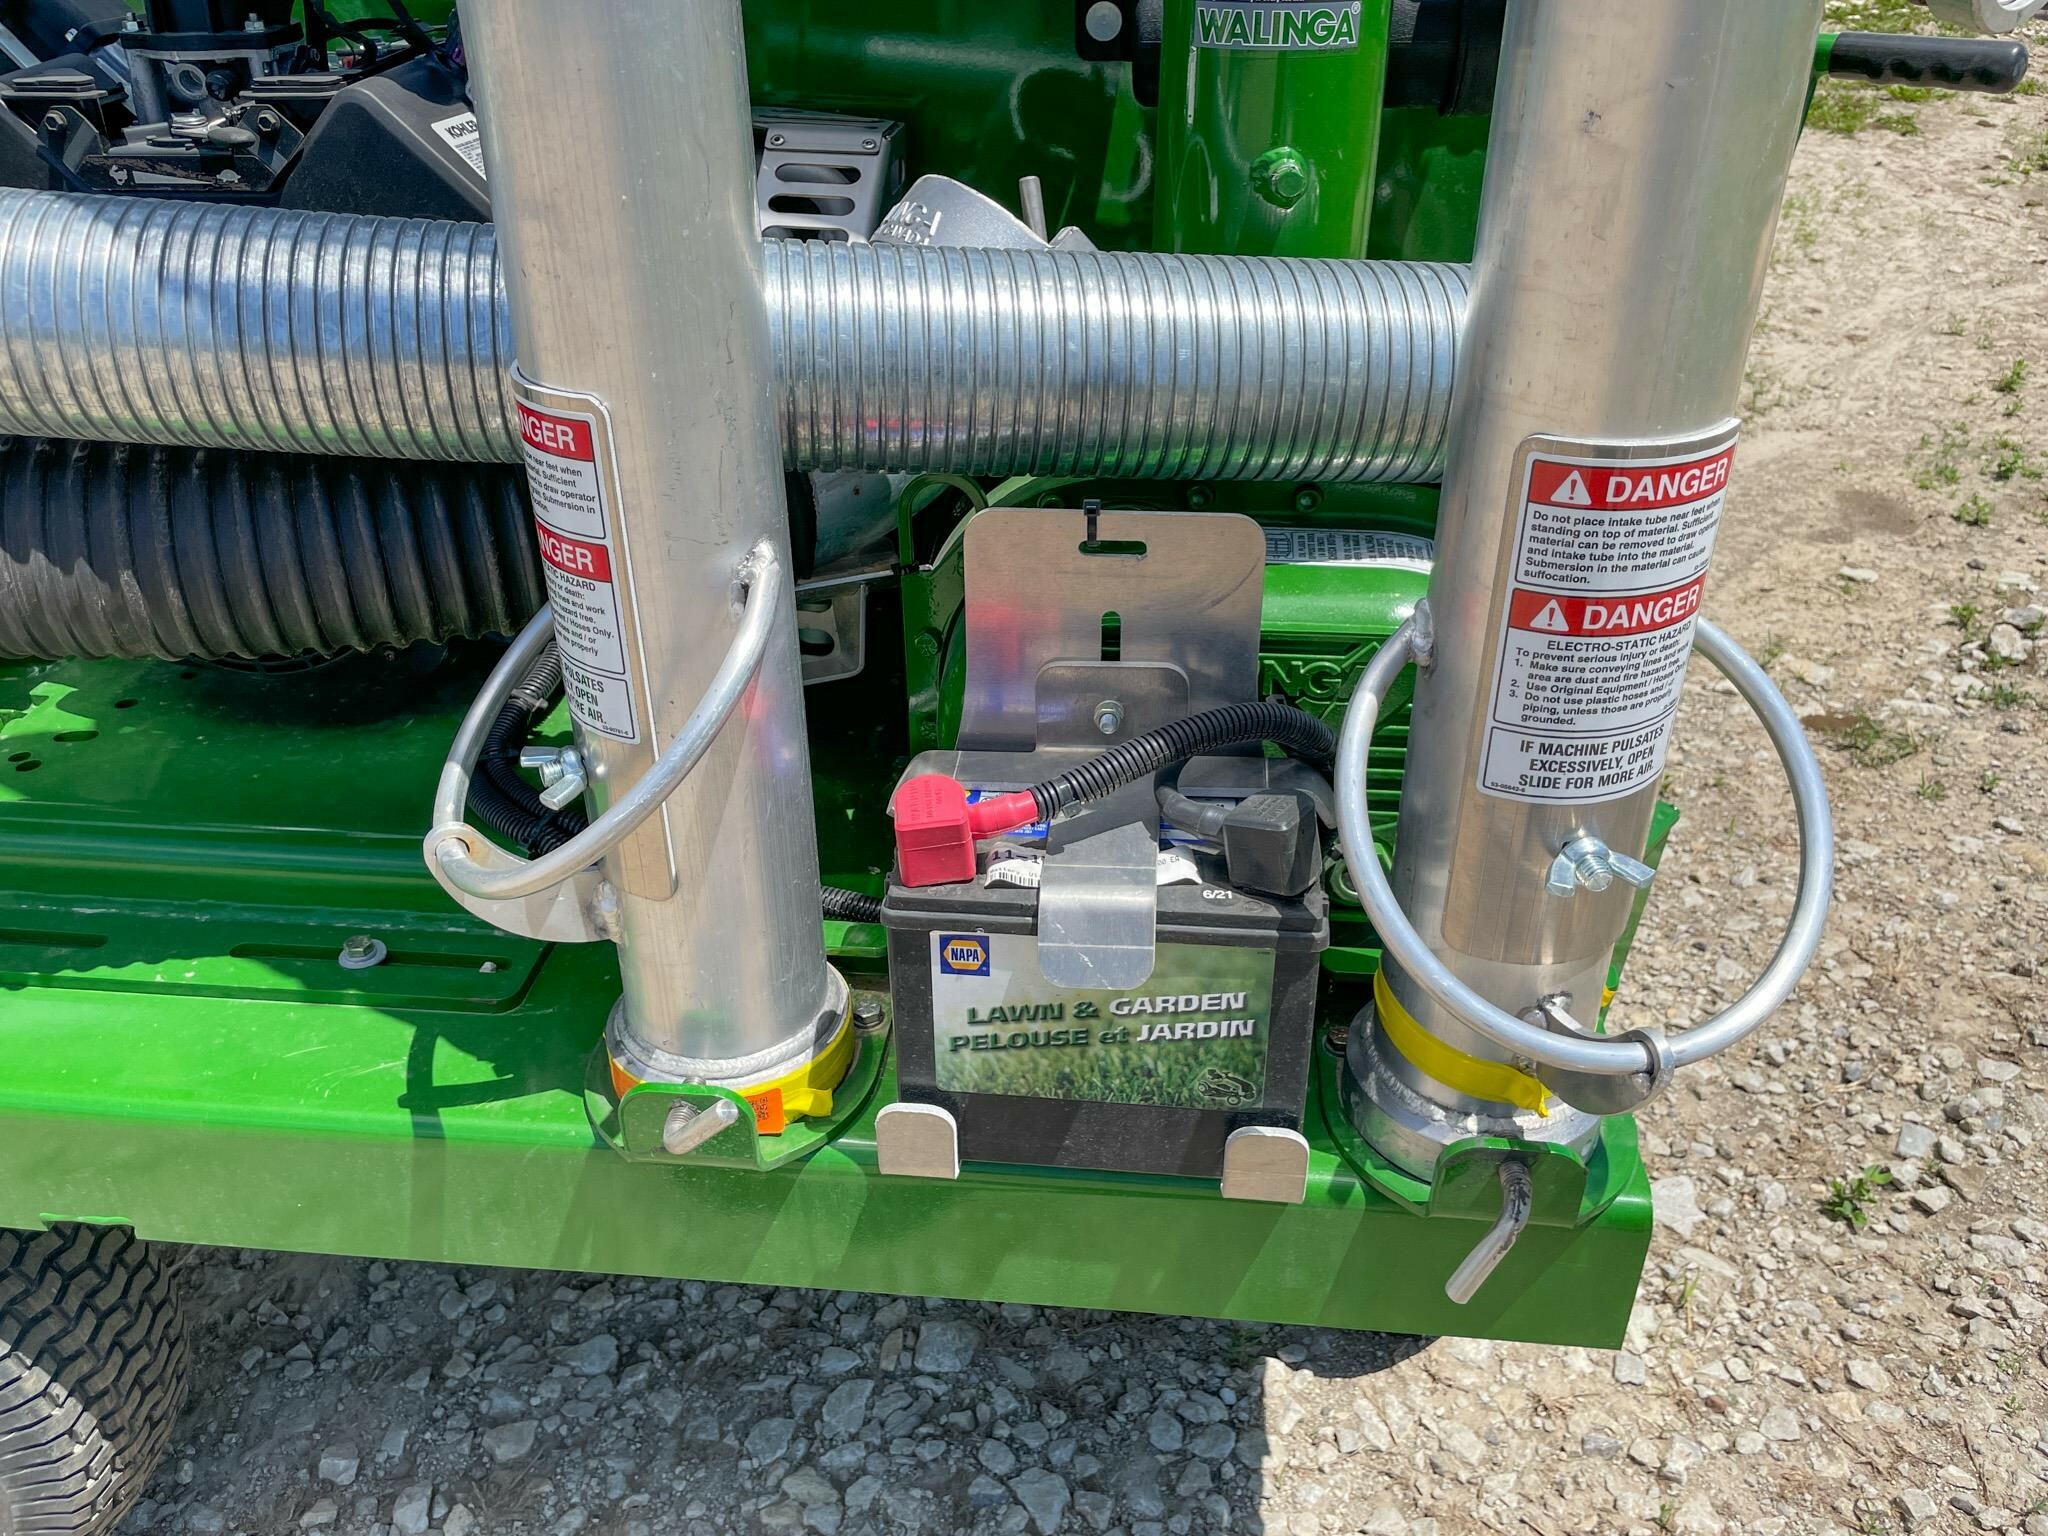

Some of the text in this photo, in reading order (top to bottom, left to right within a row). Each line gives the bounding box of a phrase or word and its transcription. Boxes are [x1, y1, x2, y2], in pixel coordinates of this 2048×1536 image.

[518, 408, 576, 451] NGER
[542, 470, 576, 487] Sufficient
[560, 466, 582, 478] when
[1605, 458, 1729, 503] DANGER
[544, 482, 558, 494] draw
[560, 490, 595, 502] operator
[542, 492, 584, 512] Submersion
[586, 505, 595, 514] in
[1531, 511, 1713, 540] standing on top of material. Sufficient
[1533, 511, 1548, 521] Do
[1551, 514, 1570, 524] not
[1574, 516, 1605, 527] place
[1608, 517, 1642, 526] intake
[1645, 514, 1667, 525] tube
[1670, 510, 1689, 522] near
[1691, 506, 1705, 517] feet
[1529, 536, 1574, 548] material
[1578, 540, 1598, 549] can
[1602, 540, 1615, 550] be
[1619, 537, 1664, 549] removed
[1667, 535, 1676, 545] to
[1678, 530, 1696, 542] draw
[540, 529, 594, 573] NGER
[1528, 541, 1695, 561] and intake tube into the material.
[1526, 557, 1593, 573] Submersion
[1598, 563, 1607, 573] in
[1611, 562, 1628, 572] the
[1631, 559, 1669, 572] material
[1672, 555, 1686, 567] can
[560, 573, 596, 591] HAZARD
[1524, 569, 1590, 584] suffocation.
[564, 586, 584, 600] death:
[571, 600, 584, 610] and
[586, 604, 606, 615] work
[1583, 584, 1699, 630] DANGER
[579, 612, 596, 624] free.
[570, 619, 590, 632] Hoses
[592, 626, 614, 639] Only.
[571, 630, 582, 640] and
[1547, 621, 1691, 652] ELECTRO-STATIC HAZARD
[571, 641, 598, 656] properly
[1516, 647, 1529, 657] To
[1533, 650, 1574, 663] prevent
[1578, 655, 1616, 663] serious
[1620, 650, 1646, 663] injury
[1515, 658, 1523, 667] 1.
[1530, 661, 1558, 672] Make
[1562, 665, 1586, 674] sure
[1589, 660, 1640, 674] conveying
[1643, 656, 1661, 668] lines
[1663, 651, 1676, 662] and
[564, 662, 604, 692] PULSATES
[1511, 680, 1519, 688] 2.
[1527, 682, 1547, 693] Use
[1550, 684, 1593, 695] Original
[1596, 679, 1646, 695] Equipment
[1653, 670, 1674, 684] Hoses
[1528, 673, 1550, 682] area
[1554, 675, 1572, 683] are
[1575, 675, 1598, 684] dust
[1601, 674, 1618, 683] and
[1623, 672, 1638, 681] fire
[1641, 665, 1666, 678] hazard
[576, 686, 598, 706] OPEN
[1509, 690, 1518, 699] 3.
[1525, 693, 1539, 702] Do
[1543, 694, 1561, 704] not
[1566, 696, 1583, 705] use
[1586, 694, 1619, 706] plastic
[1622, 691, 1648, 702] hoses
[1650, 684, 1663, 695] and
[1523, 703, 1559, 716] piping,
[1563, 707, 1598, 715] unless
[1601, 704, 1627, 714] those
[1630, 701, 1643, 710] are
[1645, 689, 1672, 708] properly
[588, 707, 606, 724] AIR.
[1521, 714, 1576, 726] grounded.
[1520, 724, 1664, 756] IF MACHINE PULSATES
[1529, 745, 1655, 773] EXCESSIVELY, OPEN
[1518, 760, 1654, 789] SLIDE FOR MORE AIR.
[1202, 890, 1232, 899] 6/21
[951, 948, 980, 962] NAPA
[967, 991, 1246, 1024] LAWN & GARDEN
[949, 1018, 1256, 1052] PELOUSE et JARDIN
